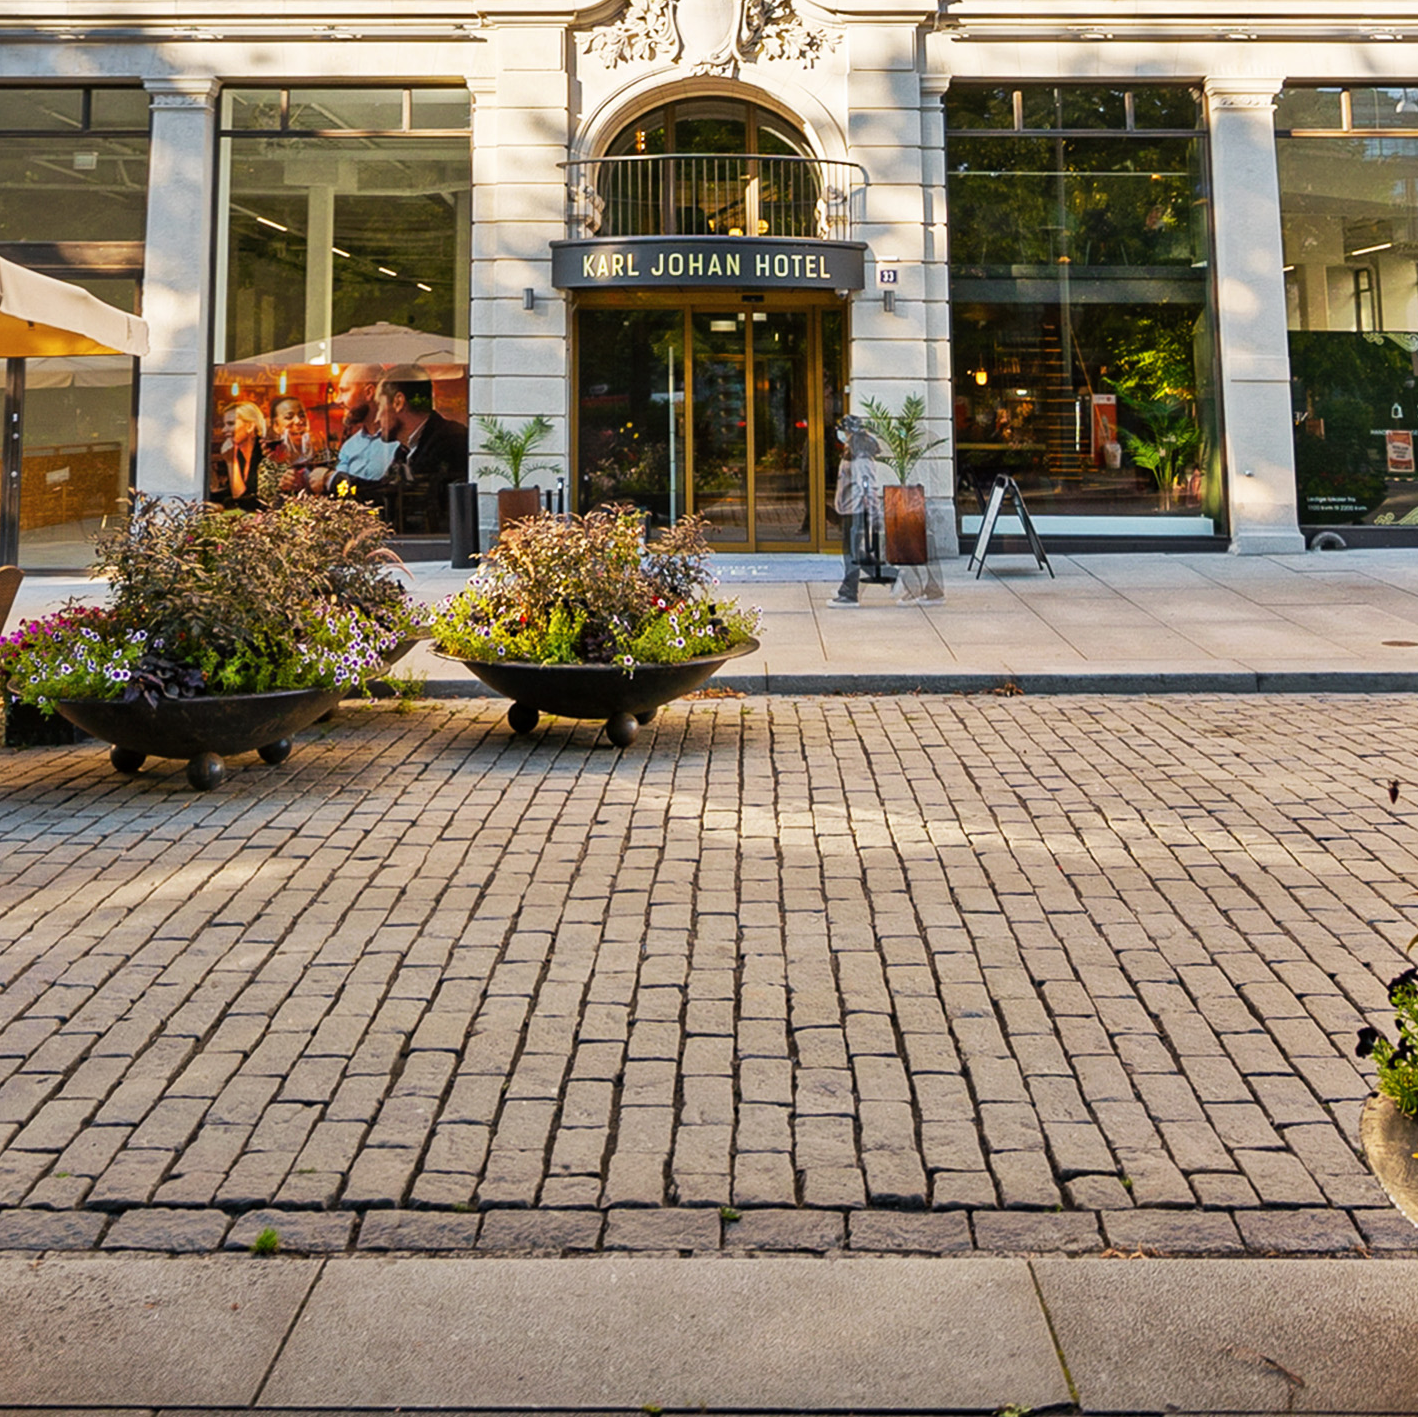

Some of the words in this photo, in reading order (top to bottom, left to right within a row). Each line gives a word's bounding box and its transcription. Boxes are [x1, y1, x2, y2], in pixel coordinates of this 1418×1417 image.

[583, 253, 639, 278] KARL
[651, 253, 740, 278] JOHAN
[755, 253, 831, 279] HOTEL
[882, 270, 895, 282] 33
